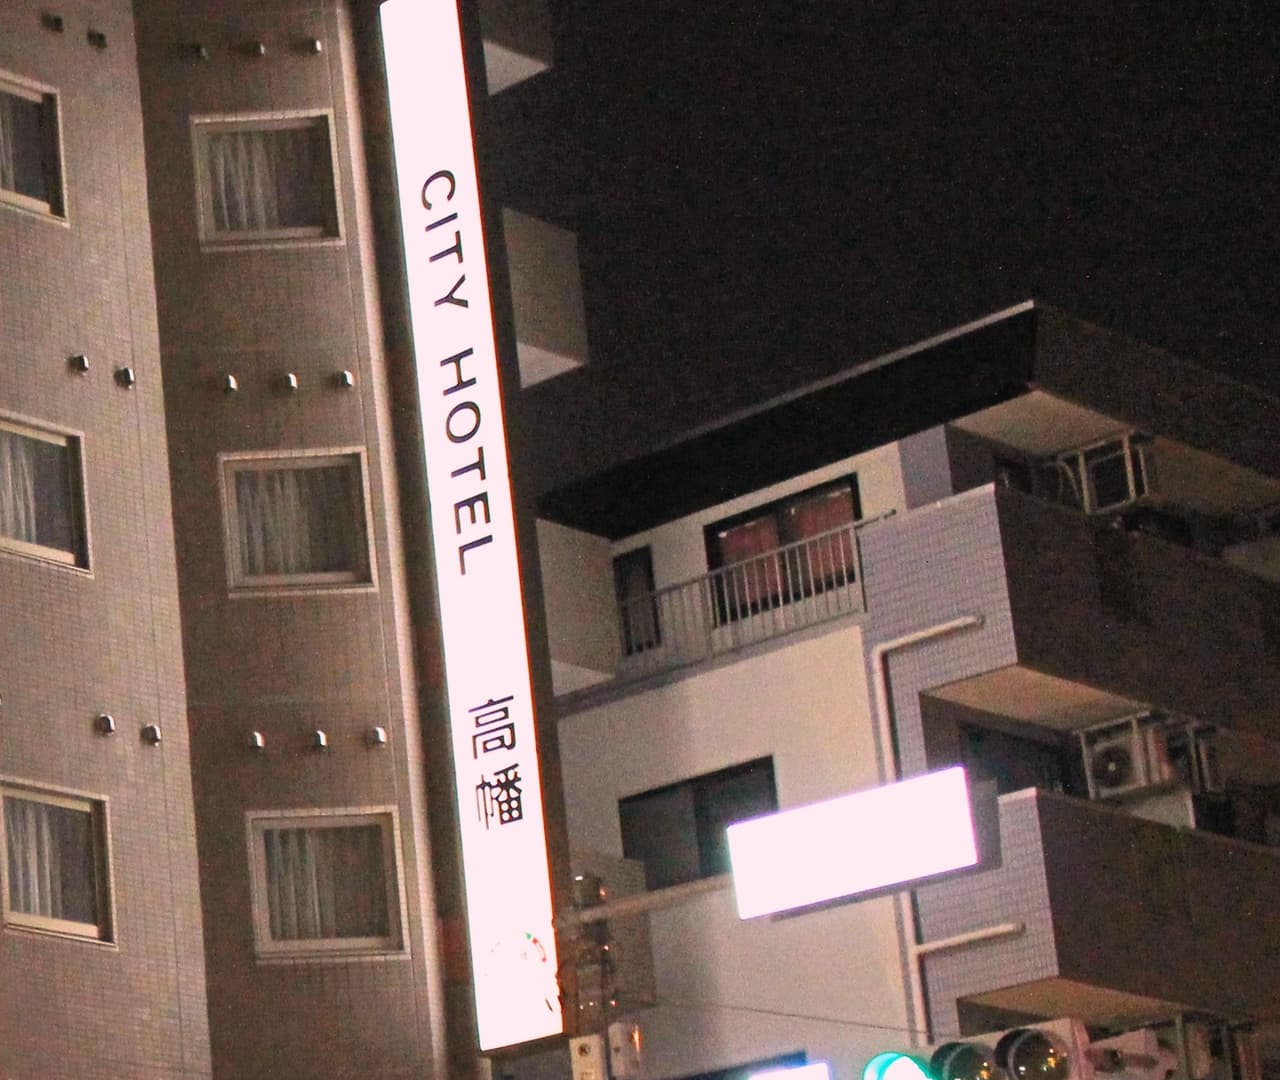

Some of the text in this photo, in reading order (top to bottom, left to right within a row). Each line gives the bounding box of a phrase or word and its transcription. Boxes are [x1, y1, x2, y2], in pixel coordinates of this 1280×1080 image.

[421, 169, 493, 575] CITY HOTEL
[468, 695, 524, 830] 高幡
